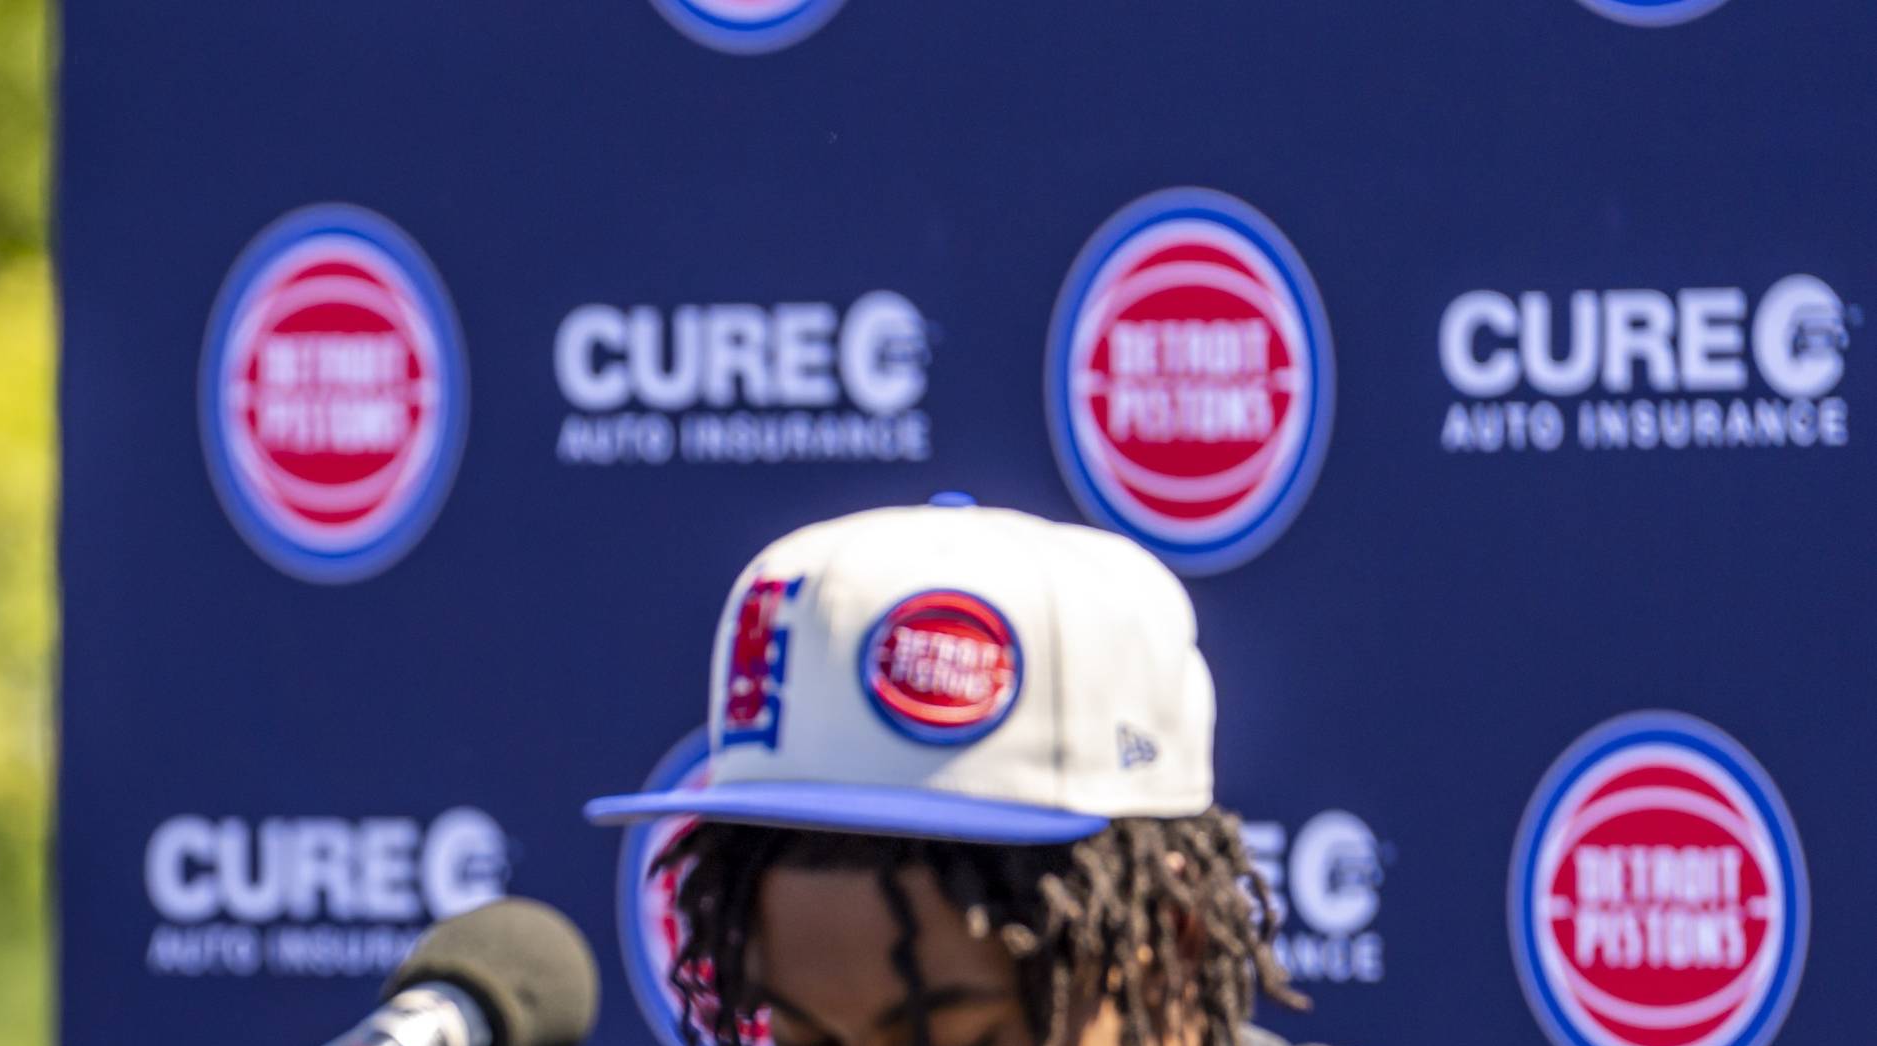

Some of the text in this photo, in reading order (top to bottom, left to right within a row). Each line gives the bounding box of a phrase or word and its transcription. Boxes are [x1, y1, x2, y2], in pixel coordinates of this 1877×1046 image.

[553, 302, 838, 412] CURE
[1111, 321, 1269, 378] DETROIT
[1437, 286, 1749, 397] CURE
[555, 408, 933, 466] AUTO INSURANCE
[1108, 382, 1272, 441] PISTONS
[1440, 396, 1850, 454] AUTO INSURANCE
[144, 813, 422, 923] CURE
[1576, 844, 1743, 903] DETROIT
[1574, 905, 1747, 970] PISTONS
